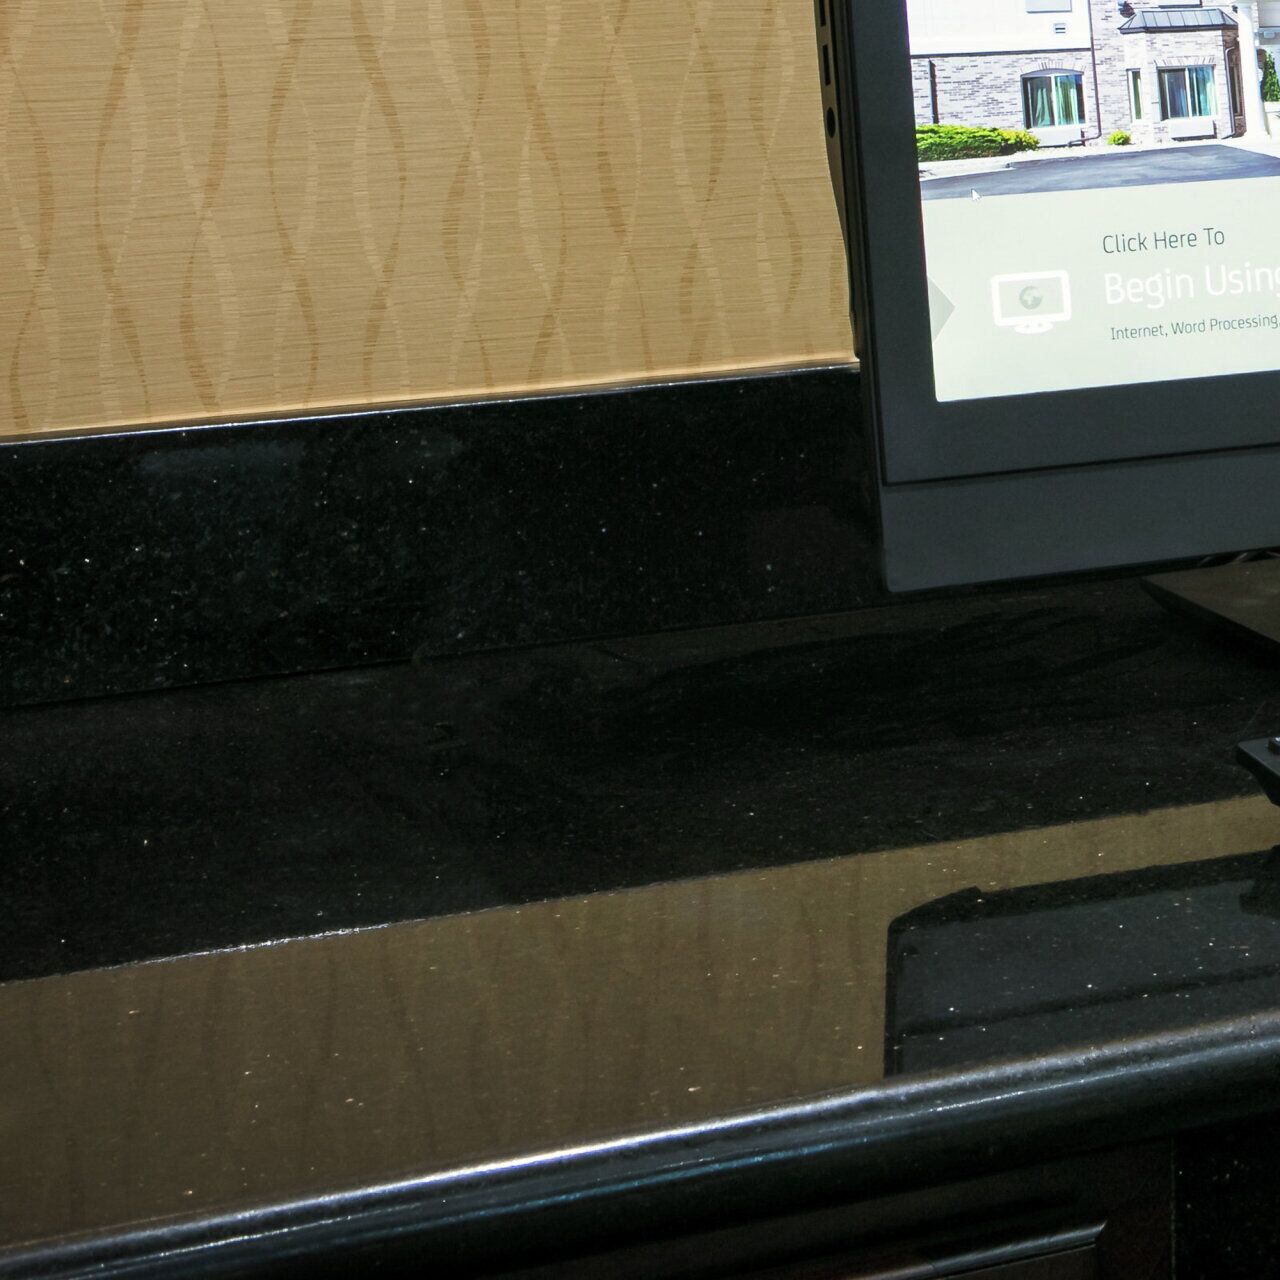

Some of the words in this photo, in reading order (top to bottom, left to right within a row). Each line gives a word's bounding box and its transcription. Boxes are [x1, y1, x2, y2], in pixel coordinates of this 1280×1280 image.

[1102, 231, 1149, 255] Click
[1153, 229, 1198, 251] Here
[1203, 227, 1226, 247] To
[1104, 269, 1195, 311] Begin
[1110, 322, 1168, 341] Internet,
[1171, 316, 1207, 335] Word
